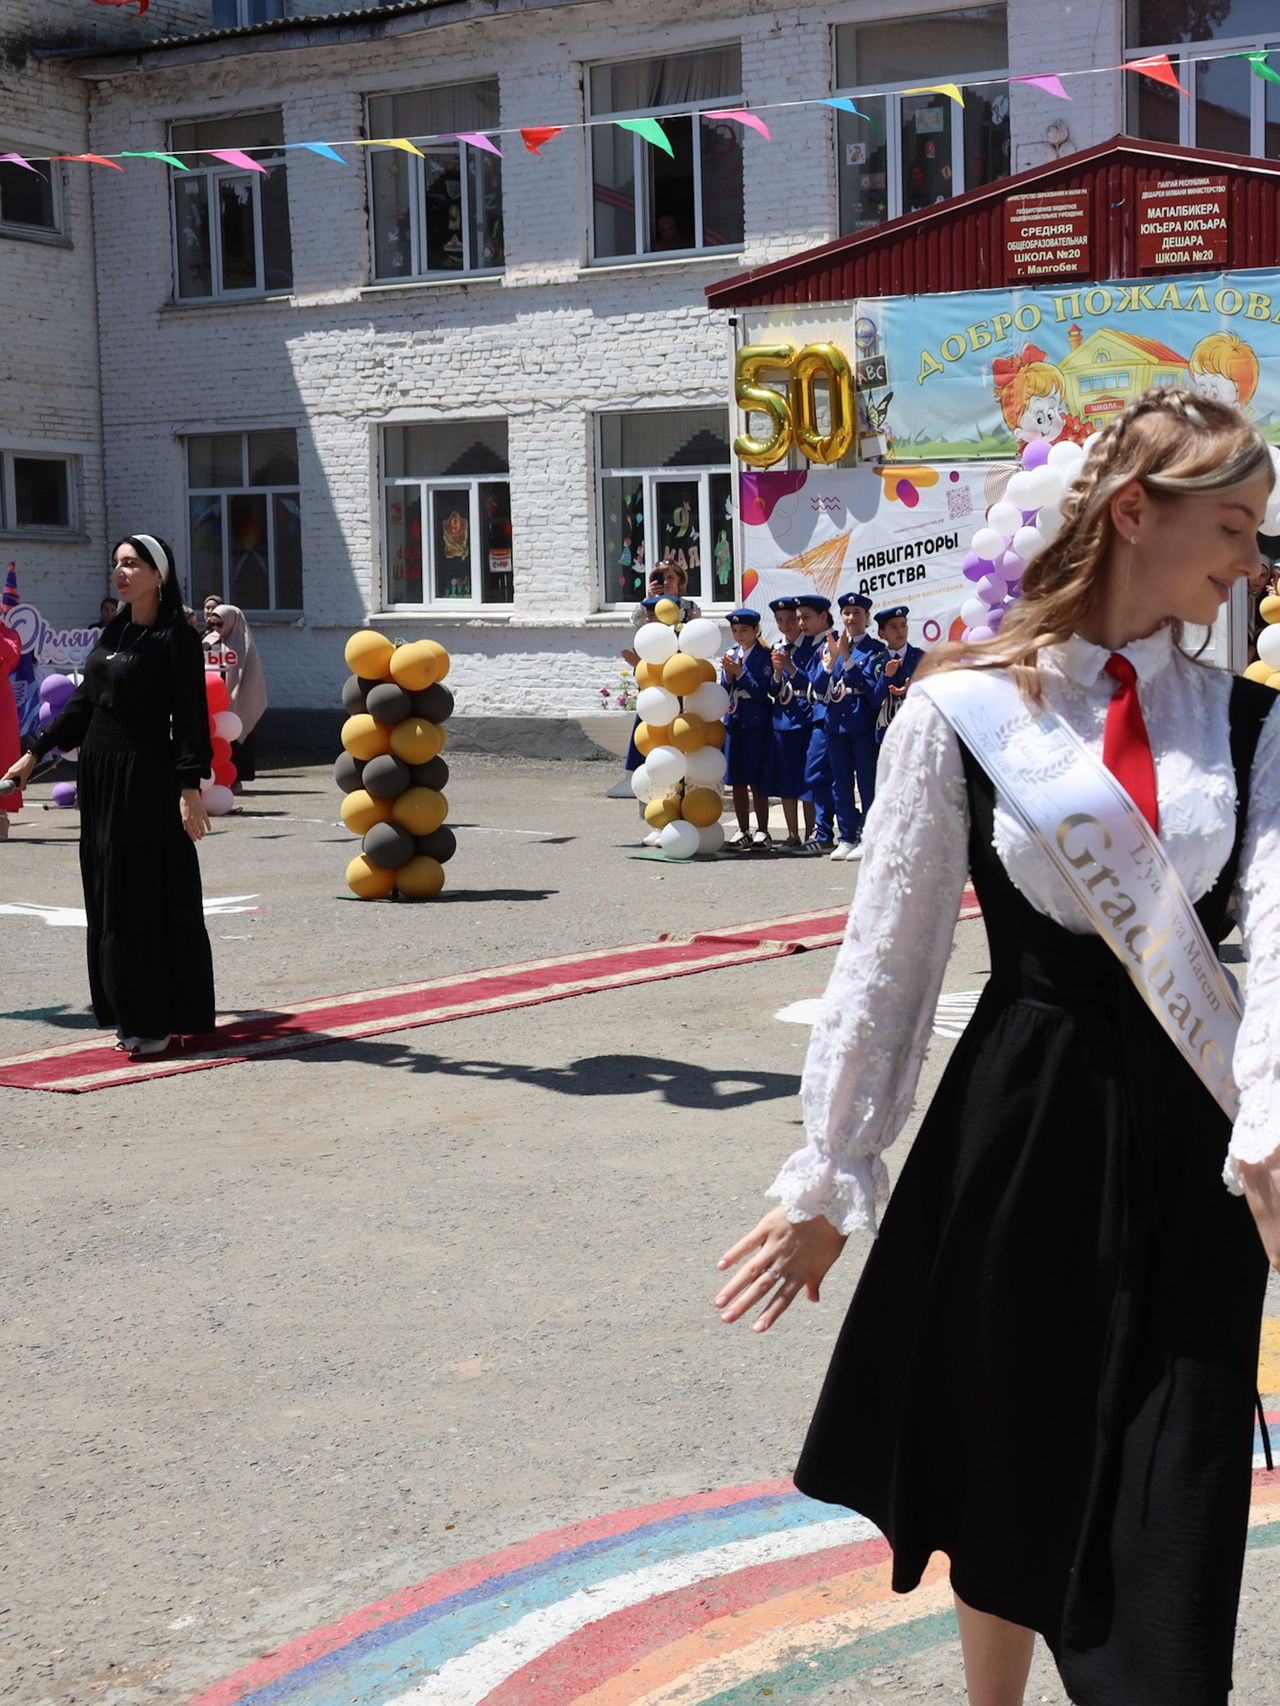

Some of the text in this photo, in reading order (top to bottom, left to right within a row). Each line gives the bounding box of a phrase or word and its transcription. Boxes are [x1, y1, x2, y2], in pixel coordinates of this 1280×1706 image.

[1178, 178, 1210, 188] РЕСПУБЛИКА
[1187, 185, 1226, 195] МИНИСТЕРСТВО
[1021, 223, 1073, 237] СРЕДНЯЯ
[1140, 218, 1227, 235] ЮКЪЕРА ЮКЪАРА
[1007, 235, 1088, 252] ОБЩЕОБРАЗОВАТЕЛЬНАЯ
[1161, 235, 1204, 250] ДЕШАРА
[1014, 248, 1081, 264] ШКОЛА №20
[1155, 249, 1214, 264] ШКОЛА №20
[1017, 262, 1078, 276] г. Малгобек
[915, 303, 1043, 385] ДОБРО
[857, 364, 885, 386] ABC
[733, 341, 856, 471] 50
[1091, 402, 1118, 411] ШКОЛА
[450, 517, 461, 533] 9
[673, 506, 690, 538] 9
[856, 532, 959, 573] НАВИГАТОРЫ
[859, 564, 926, 596] ДЕТСТВА
[882, 593, 921, 608] философия
[921, 583, 964, 598] воспитания
[9, 606, 101, 656] Орлят
[1056, 812, 1224, 1075] Graduate
[1183, 937, 1221, 1013] Marem
